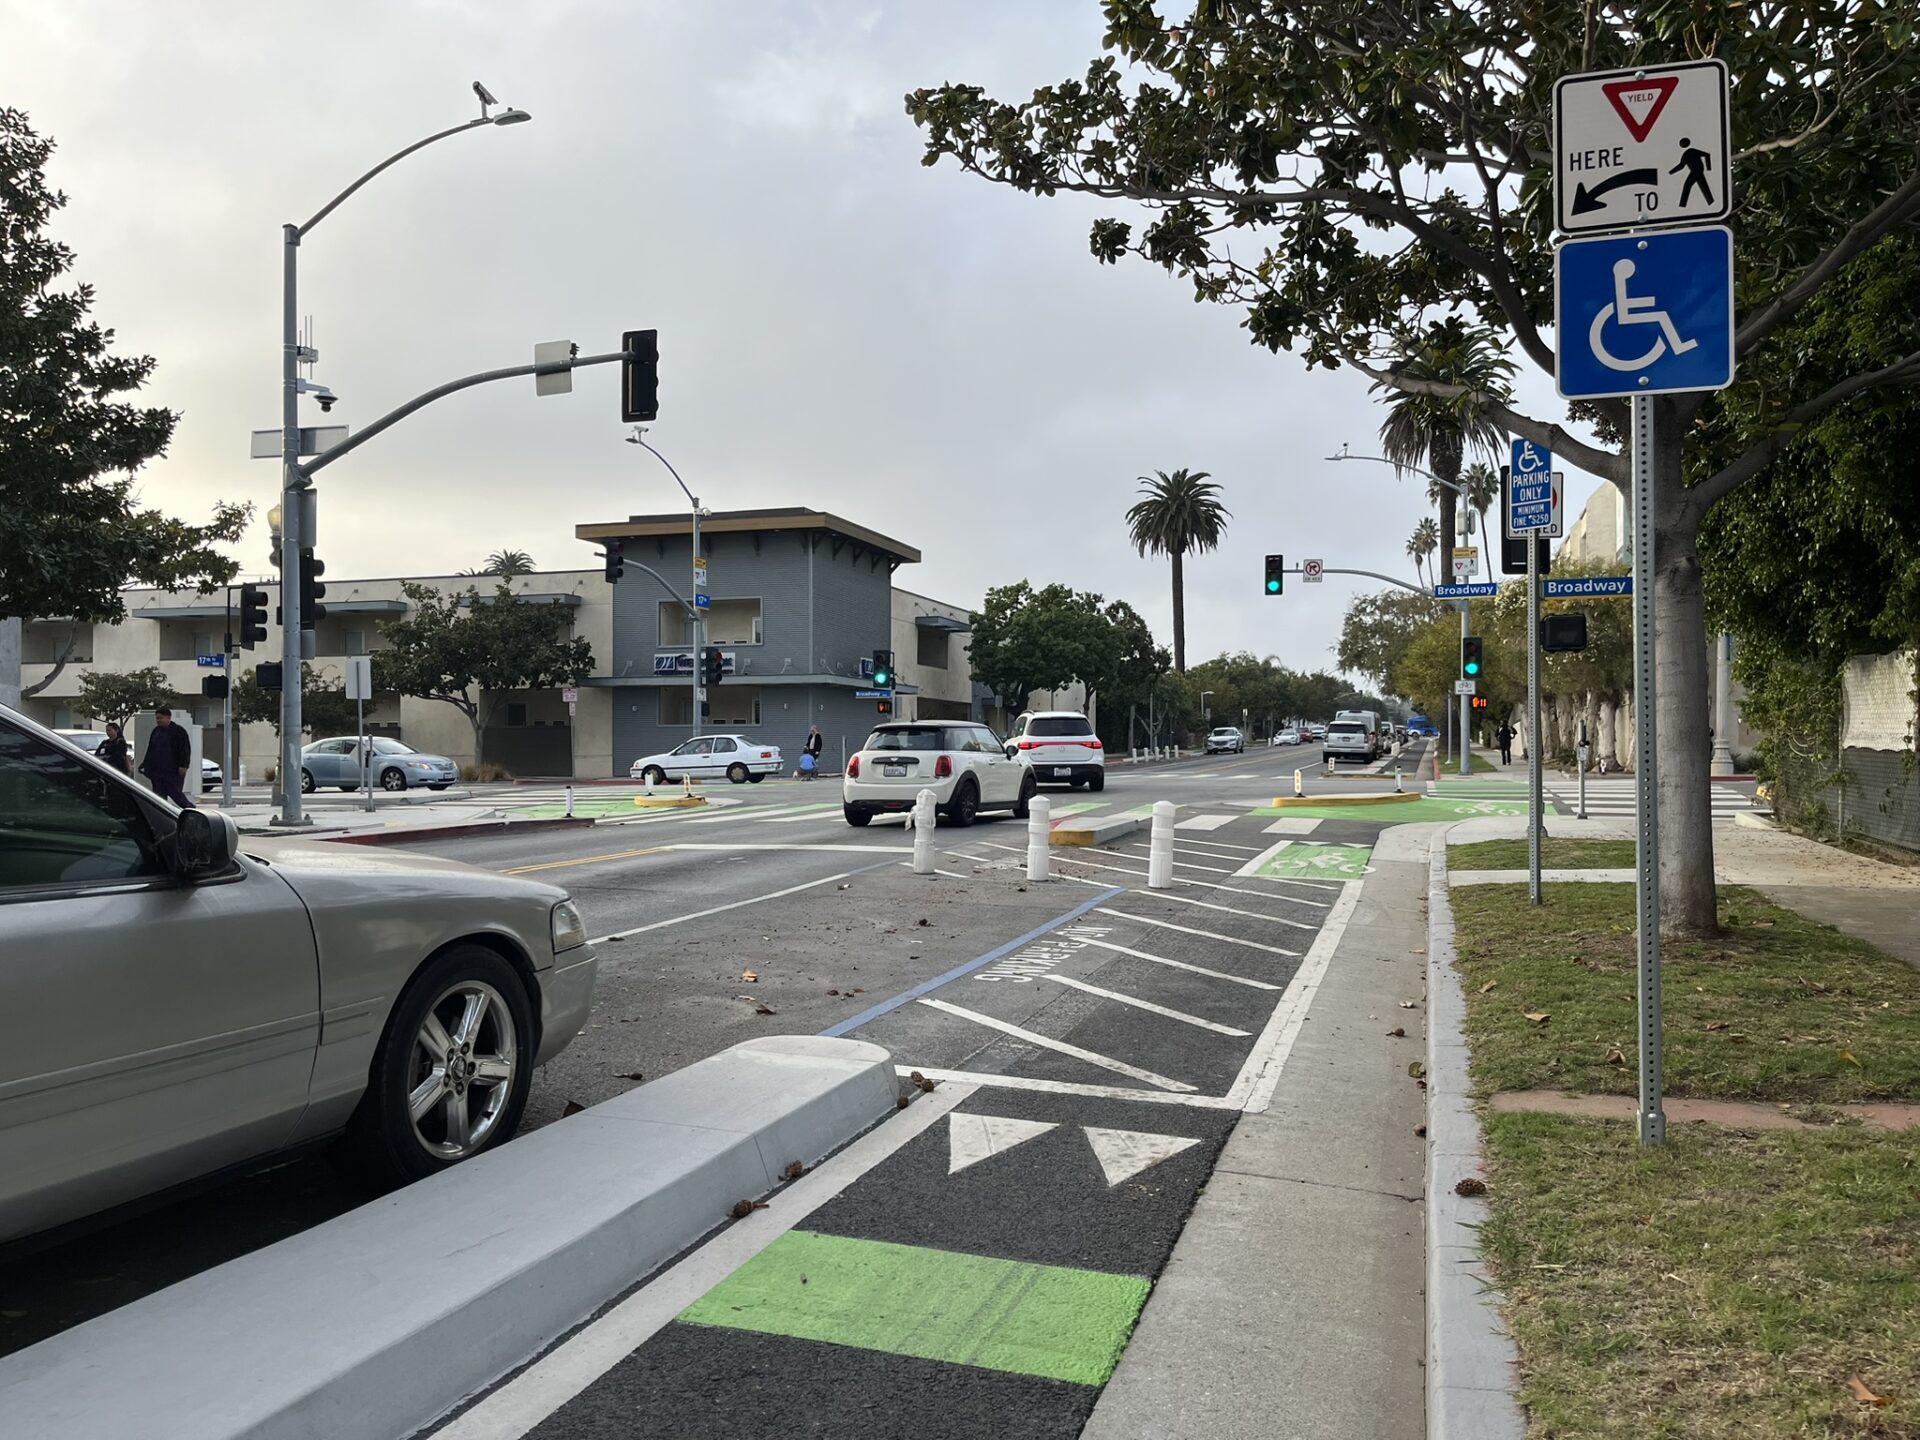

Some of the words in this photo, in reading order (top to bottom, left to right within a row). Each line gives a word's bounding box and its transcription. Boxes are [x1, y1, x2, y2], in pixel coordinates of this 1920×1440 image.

[1627, 93, 1654, 103] YIELD
[1569, 147, 1624, 171] HERE
[1634, 191, 1658, 212] TO
[1513, 471, 1549, 488] PARKING
[1520, 486, 1542, 501] ONLY
[1517, 503, 1545, 515] MINIMUM
[1513, 517, 1527, 527] FINE
[1437, 585, 1494, 595] Broadway
[1548, 579, 1626, 593] Broadway
[1056, 925, 1113, 938] NO
[974, 941, 1089, 983] PARKING
